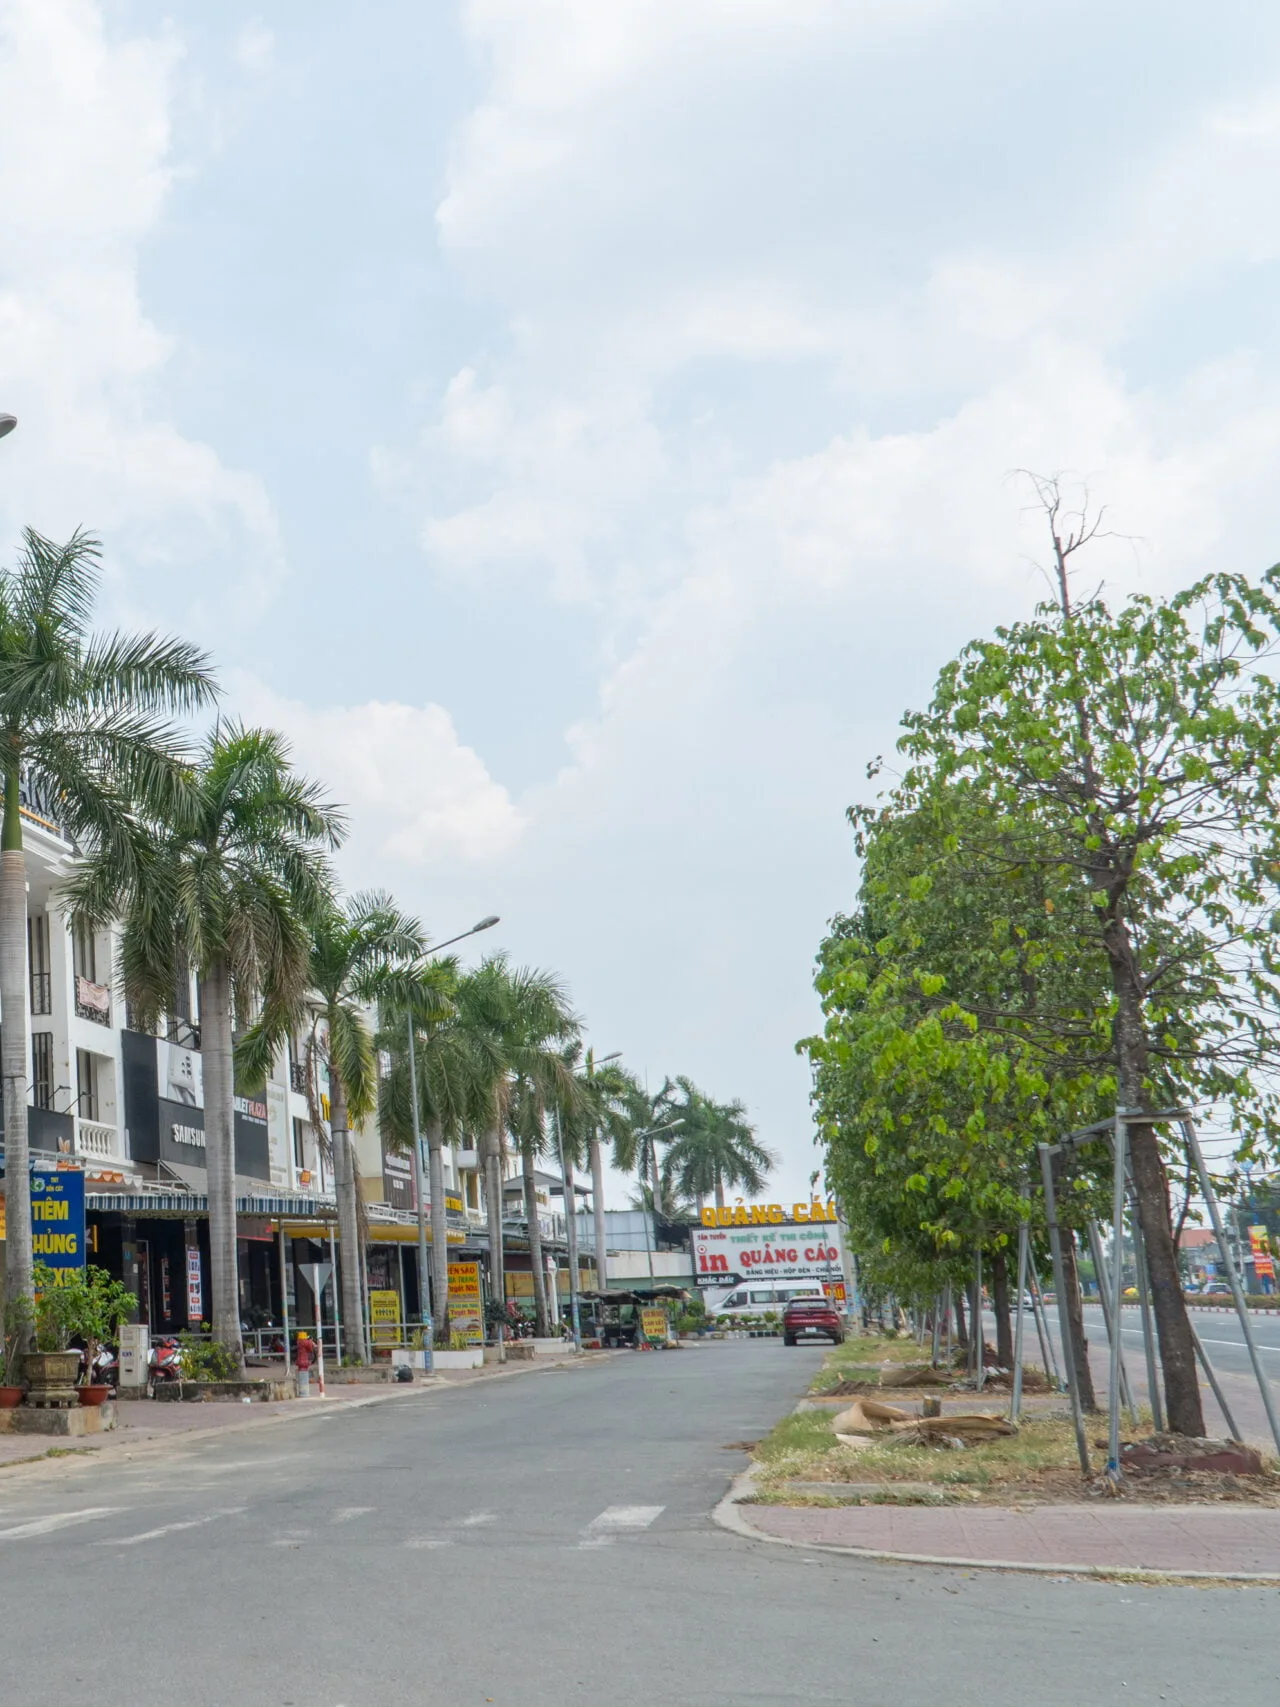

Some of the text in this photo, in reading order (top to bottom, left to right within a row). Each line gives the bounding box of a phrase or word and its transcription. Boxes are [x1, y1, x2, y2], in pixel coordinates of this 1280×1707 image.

[172, 1124, 206, 1148] SAMSUN
[32, 1197, 69, 1220] TIÊM
[701, 1197, 783, 1228] QUẢNG
[32, 1228, 77, 1254] HỦNG
[739, 1243, 839, 1268] QUẢNG CÁO
